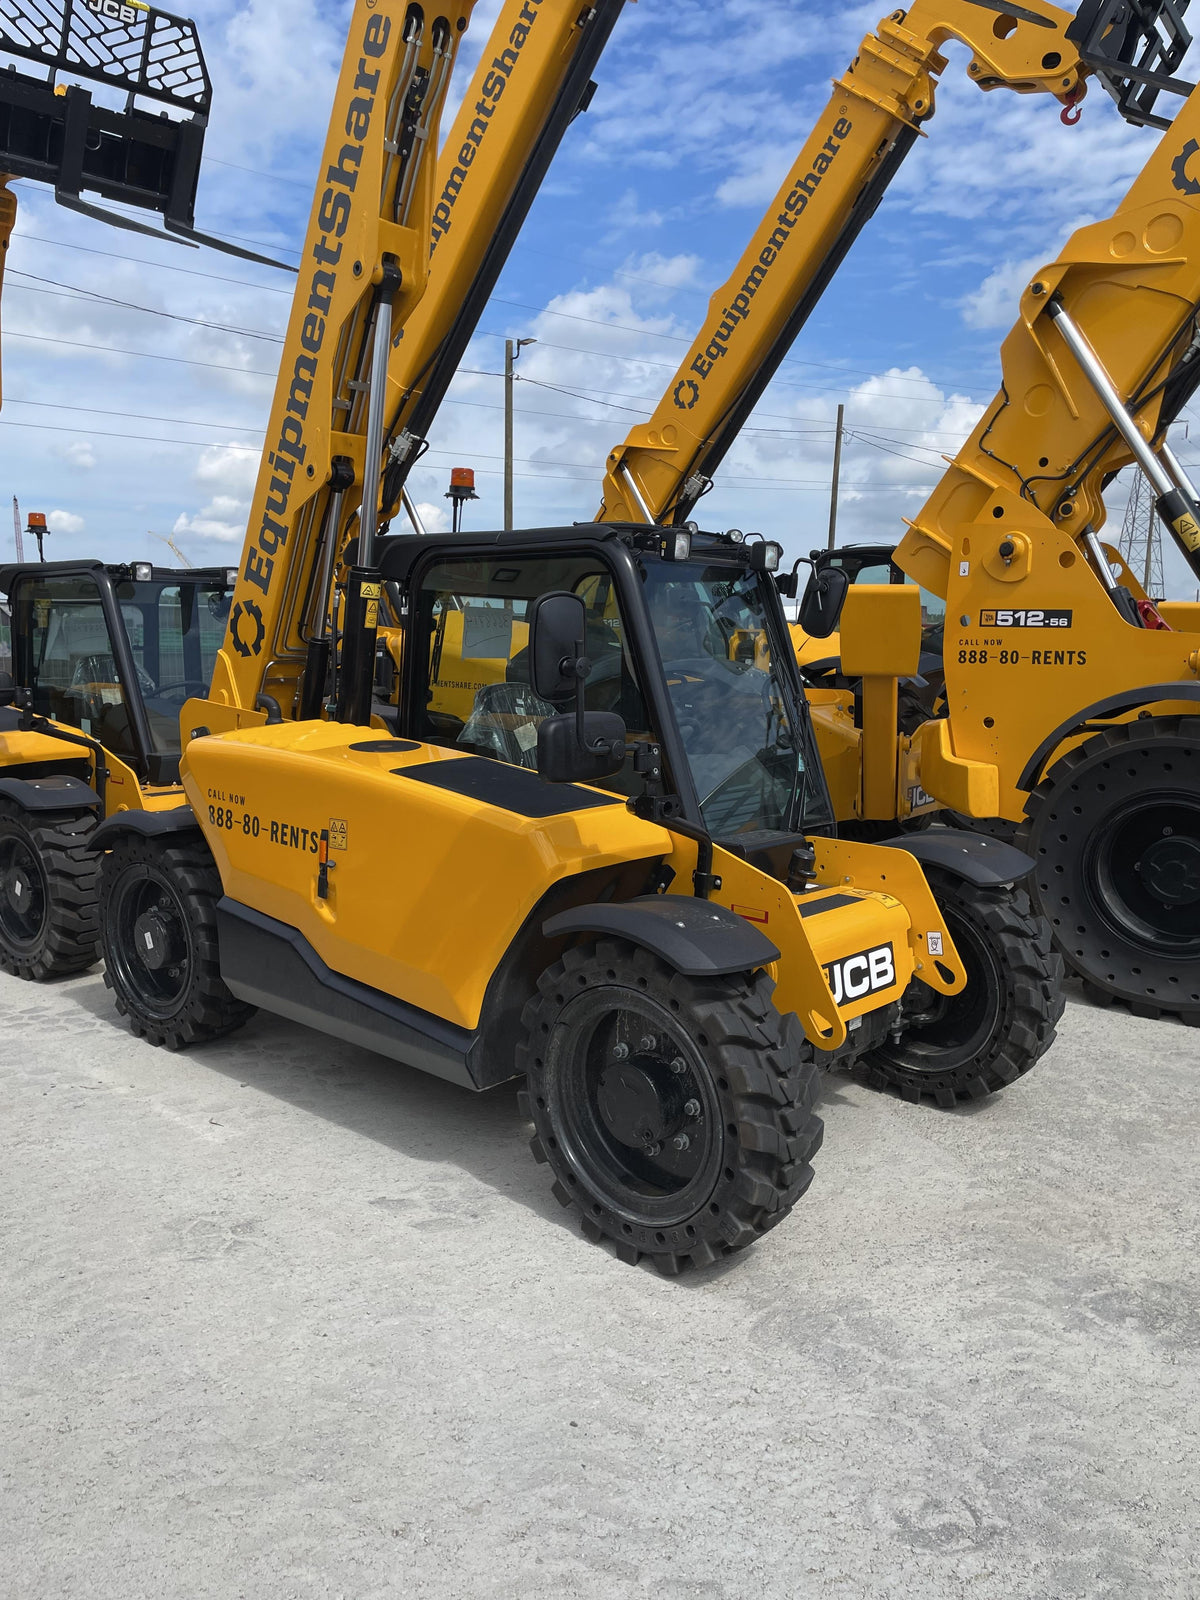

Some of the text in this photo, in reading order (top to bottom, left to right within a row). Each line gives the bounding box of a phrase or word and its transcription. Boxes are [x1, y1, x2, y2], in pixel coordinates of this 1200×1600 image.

[88, 0, 136, 24] JCB
[690, 117, 852, 381] EquipmentShare
[244, 14, 391, 596] EquipmentShare
[958, 650, 1087, 666] 888-80-RENTS
[208, 788, 246, 806] CALL NOW
[208, 804, 319, 854] 888-80-RENTS
[833, 947, 894, 1004] JCB
